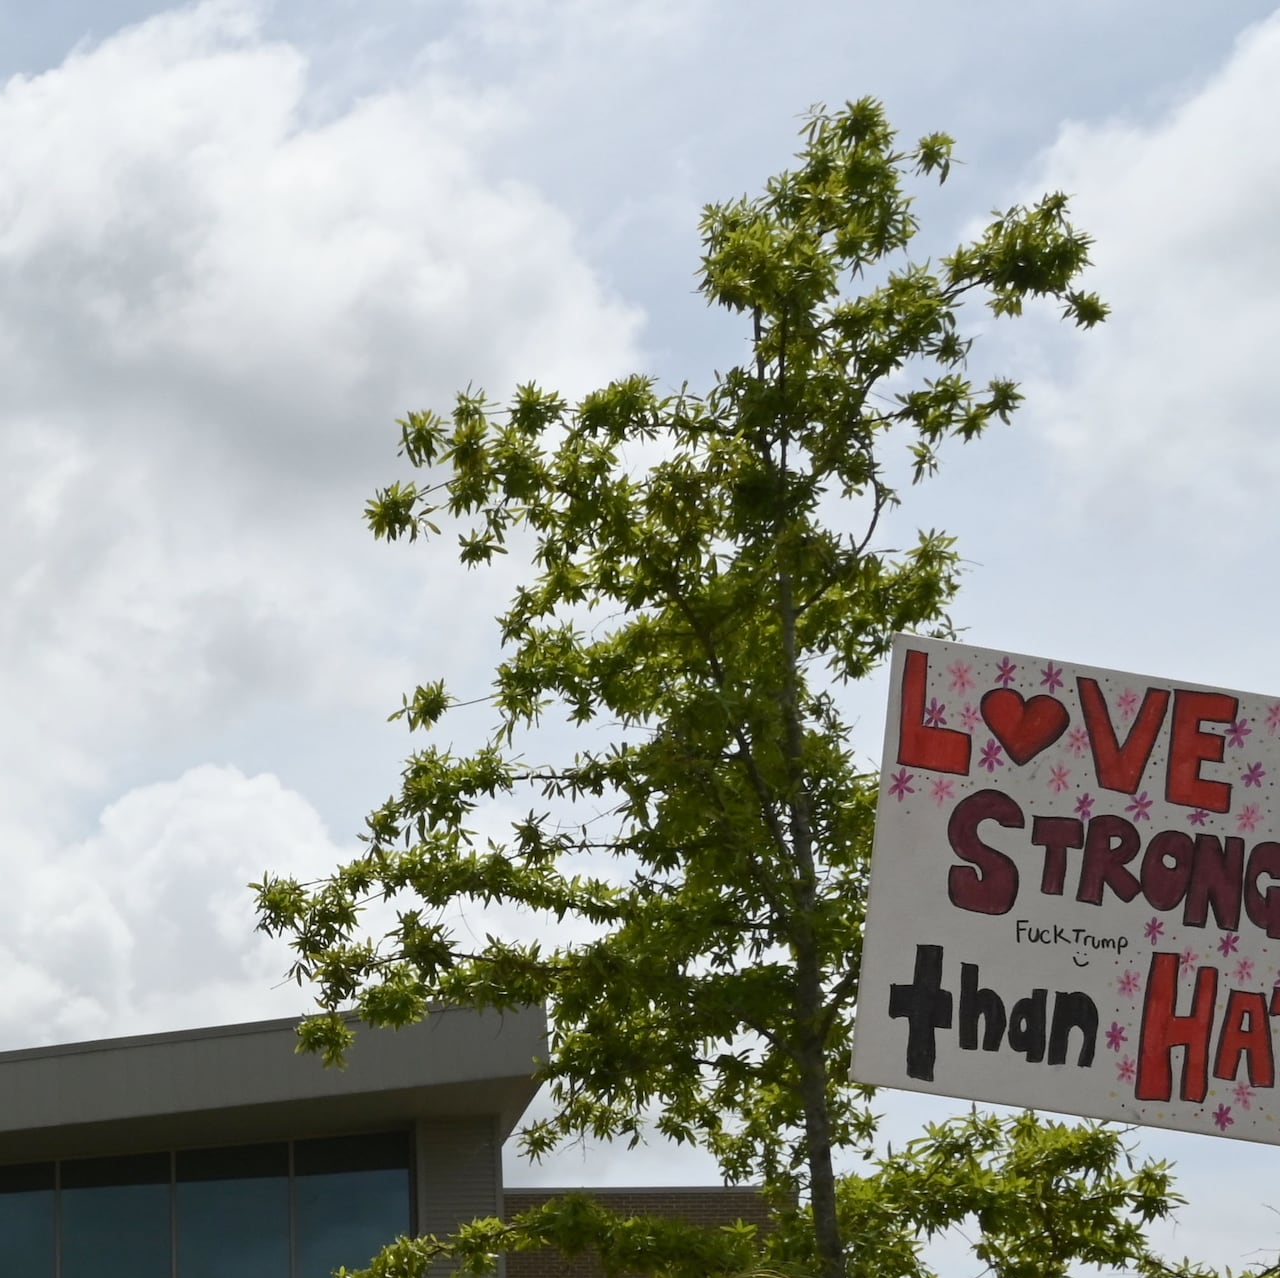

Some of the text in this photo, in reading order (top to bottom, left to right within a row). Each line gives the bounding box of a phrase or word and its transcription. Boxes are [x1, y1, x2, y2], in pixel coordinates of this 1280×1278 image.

[948, 789, 1280, 939] STRONG
[1016, 919, 1129, 955] Fuck Trump
[889, 944, 1280, 1103] than HA
